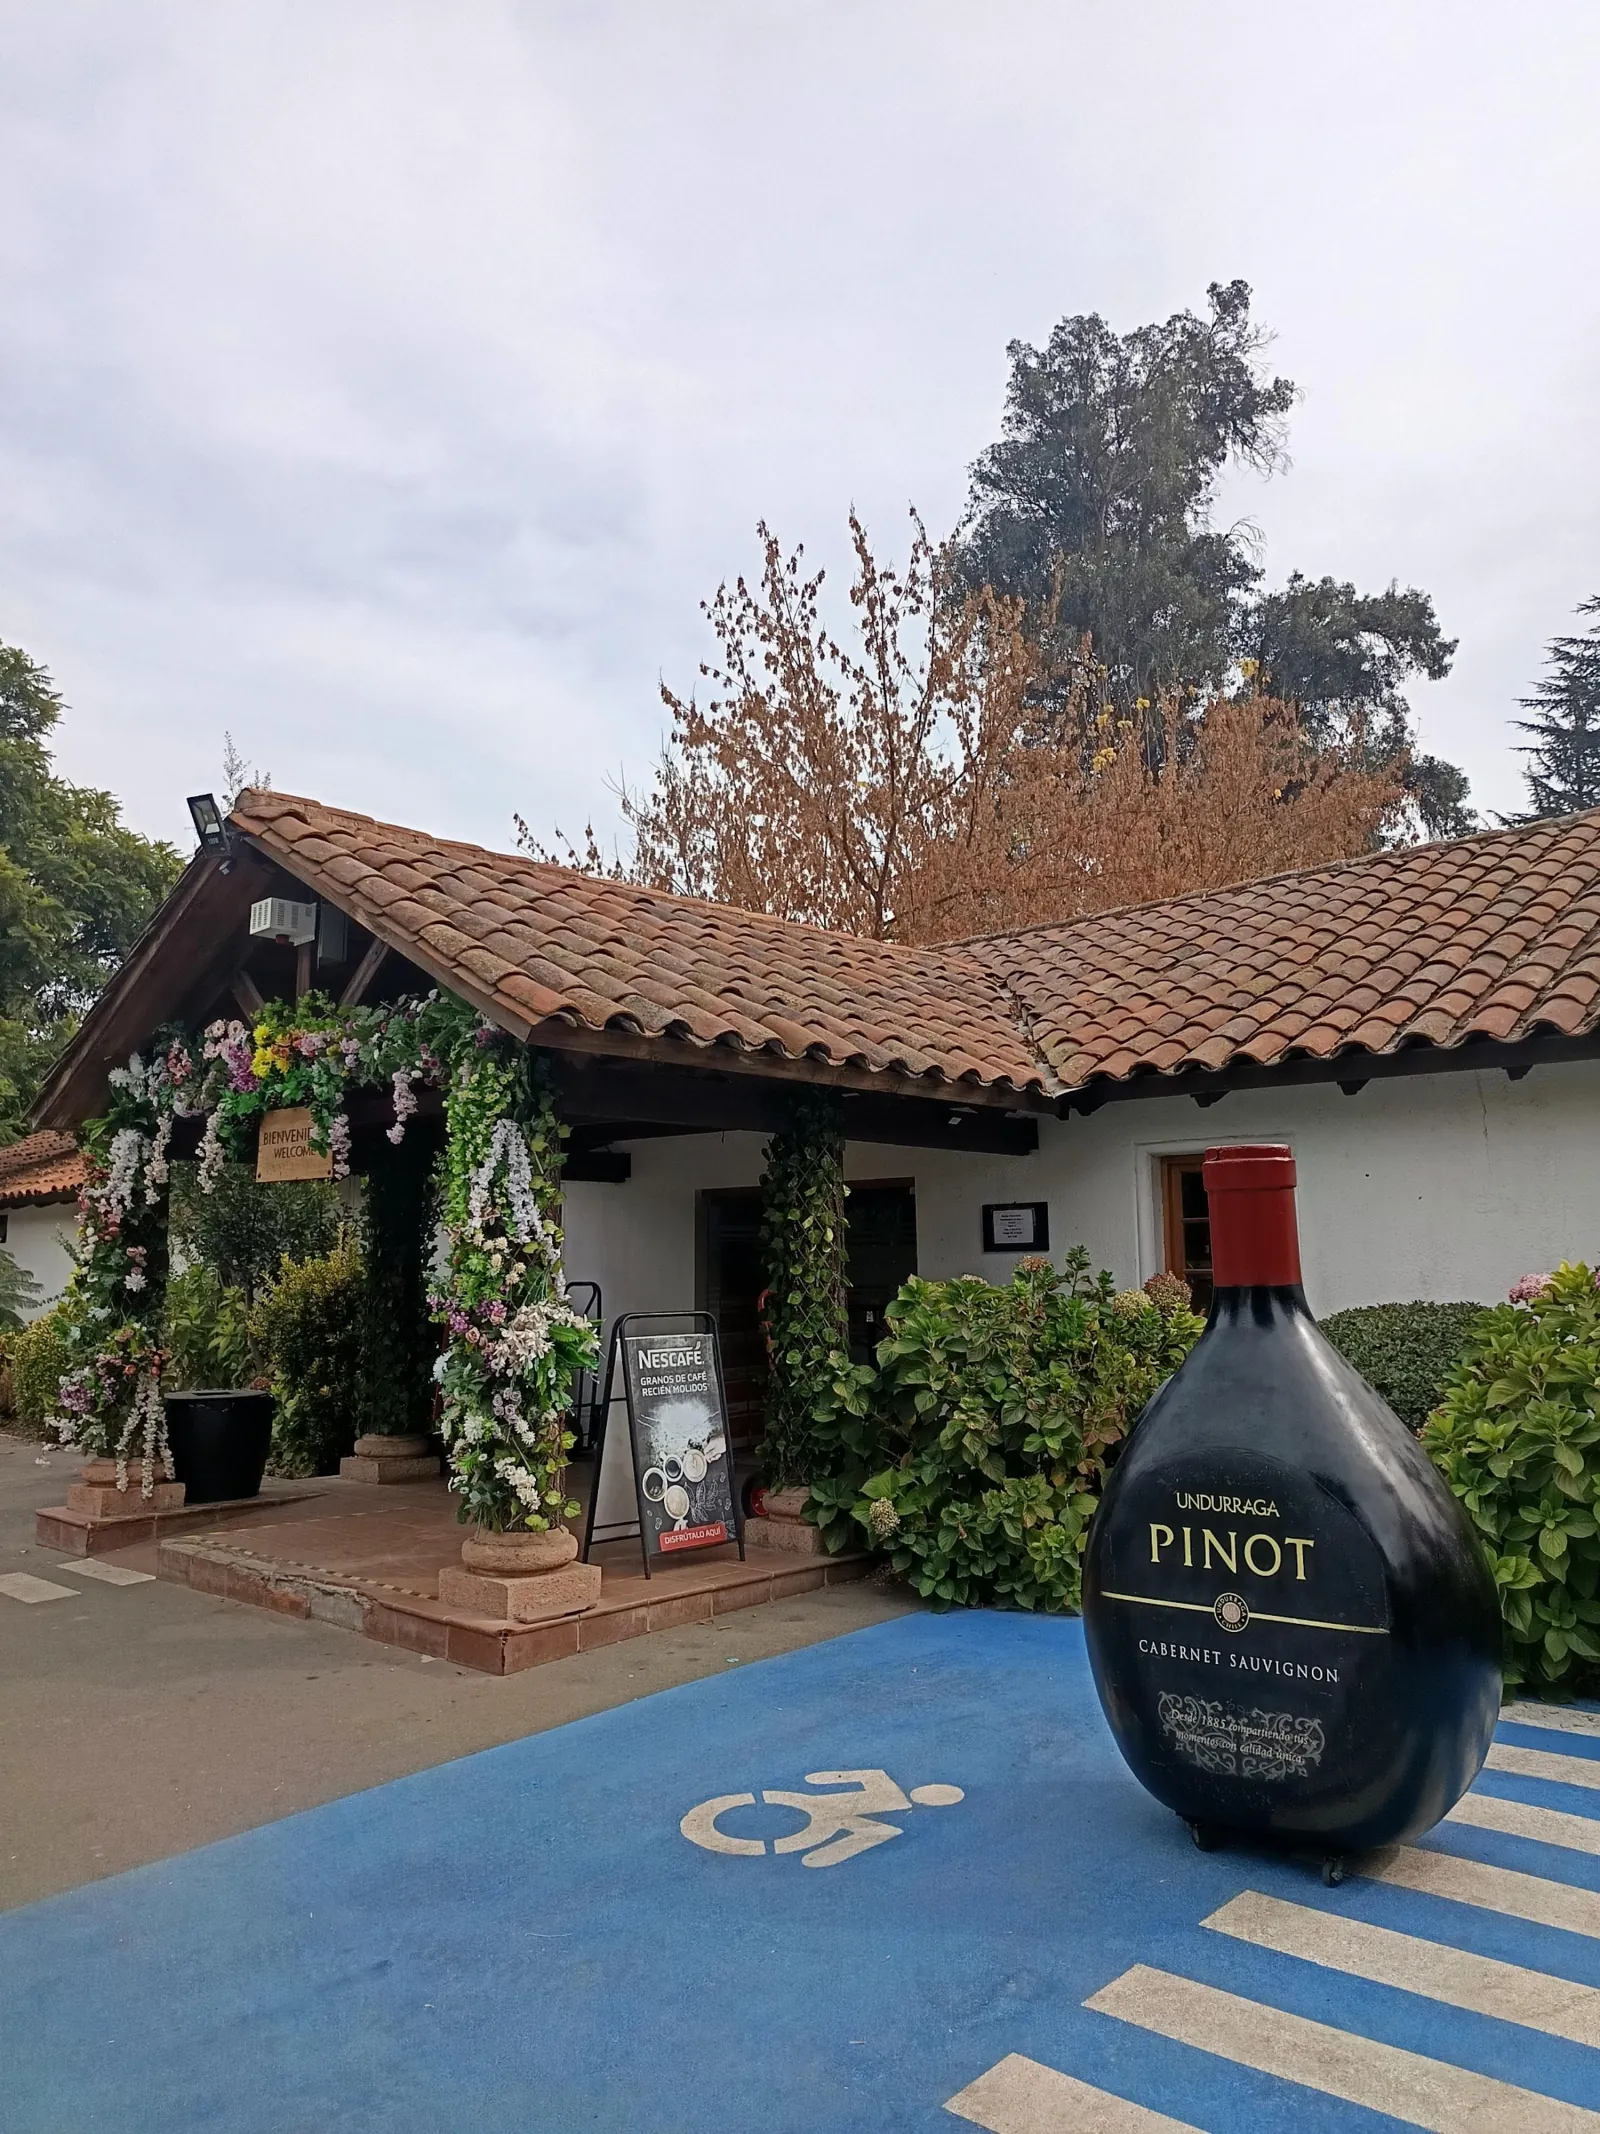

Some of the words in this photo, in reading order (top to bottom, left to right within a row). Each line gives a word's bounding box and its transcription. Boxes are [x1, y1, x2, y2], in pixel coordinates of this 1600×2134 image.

[640, 1374, 674, 1386] GRANOS
[675, 1374, 686, 1383] DE
[687, 1370, 707, 1382] CAFÉ
[642, 1385, 671, 1397] RECIÉN
[672, 1382, 708, 1394] MOLIDOS
[1176, 1492, 1280, 1517] UNDURRAGA
[664, 1530, 705, 1544] DISFRÚTALO
[705, 1526, 721, 1537] AQUÍ
[1149, 1523, 1315, 1580] PINOT
[1221, 1620, 1242, 1630] CHILE
[1139, 1639, 1221, 1665] CABERNET
[1230, 1654, 1339, 1683] SAUVIGNON
[1171, 1709, 1198, 1723] Desde
[1202, 1715, 1226, 1729] 1885
[1228, 1722, 1290, 1741] compartiendo
[1294, 1734, 1308, 1745] tus
[1176, 1731, 1219, 1747] momentos
[1222, 1740, 1237, 1750] con
[1240, 1742, 1273, 1758] calidad
